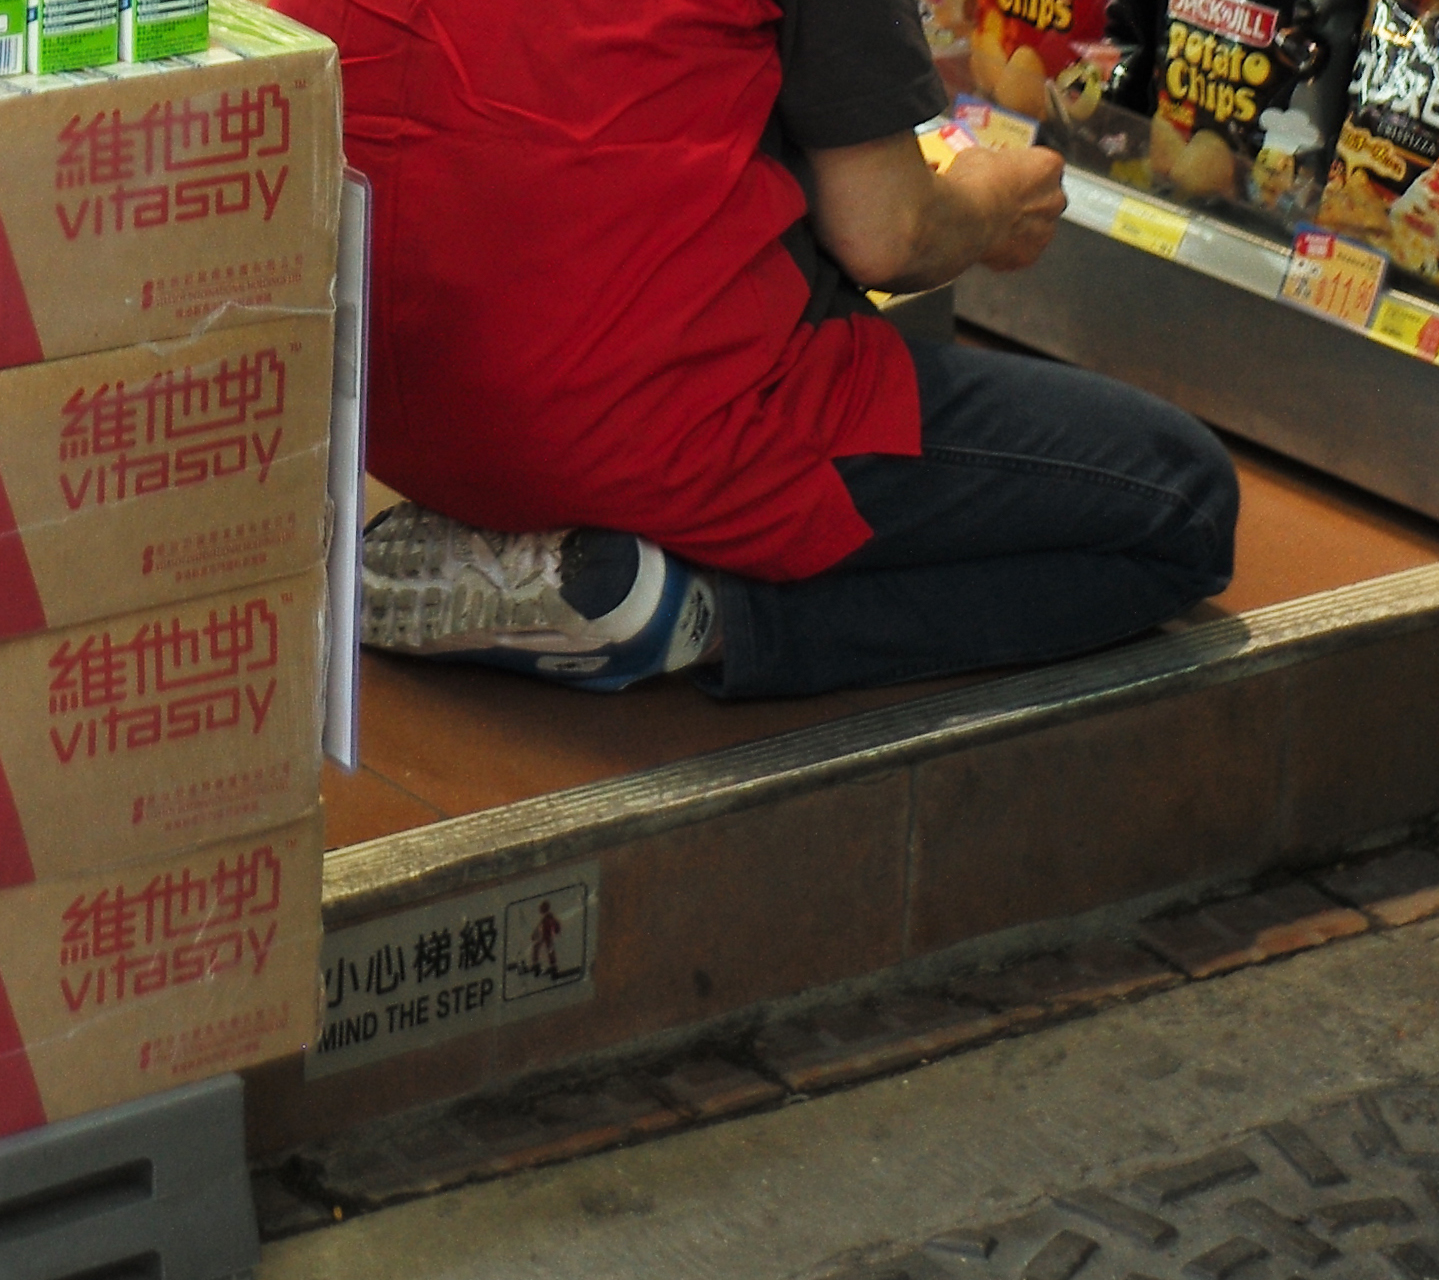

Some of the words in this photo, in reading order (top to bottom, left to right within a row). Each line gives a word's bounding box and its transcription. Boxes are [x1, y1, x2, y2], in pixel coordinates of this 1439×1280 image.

[1165, 56, 1258, 125] Chips
[1167, 19, 1272, 84] Potato
[54, 83, 292, 192] 維他奶
[53, 164, 290, 242] vitasoy
[59, 344, 288, 462] 維他奶
[57, 429, 284, 512] vitasoy
[47, 596, 280, 714] 維他奶
[47, 678, 278, 767] vitasoy
[59, 843, 282, 964] 維他奶
[59, 921, 278, 1013] vitasoy
[324, 914, 499, 1010] 小心梯級
[317, 1010, 379, 1055] MIND
[384, 993, 431, 1035] THE
[435, 976, 495, 1020] STEP
